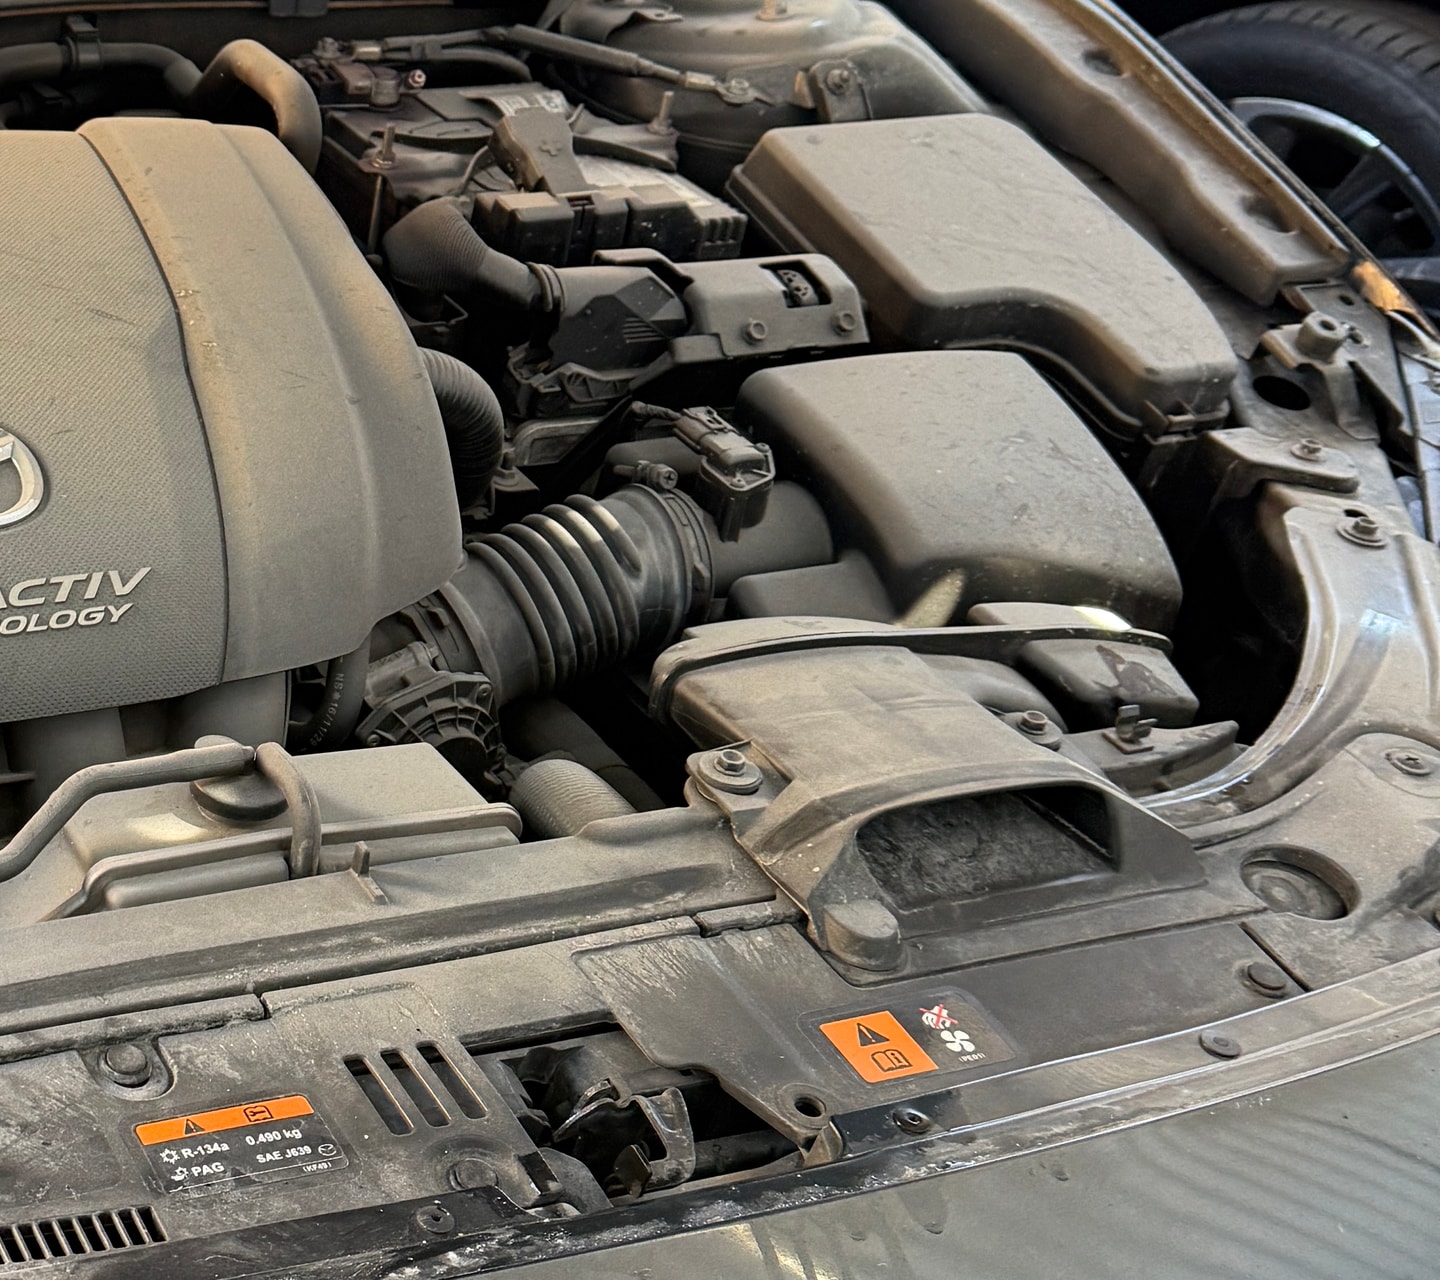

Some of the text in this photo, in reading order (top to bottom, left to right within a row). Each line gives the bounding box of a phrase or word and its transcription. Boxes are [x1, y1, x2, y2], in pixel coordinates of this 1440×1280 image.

[284, 1128, 302, 1140] kg
[181, 1142, 230, 1159] R-134a
[256, 1146, 311, 1164] SAE J639
[191, 1162, 224, 1177] PAG
